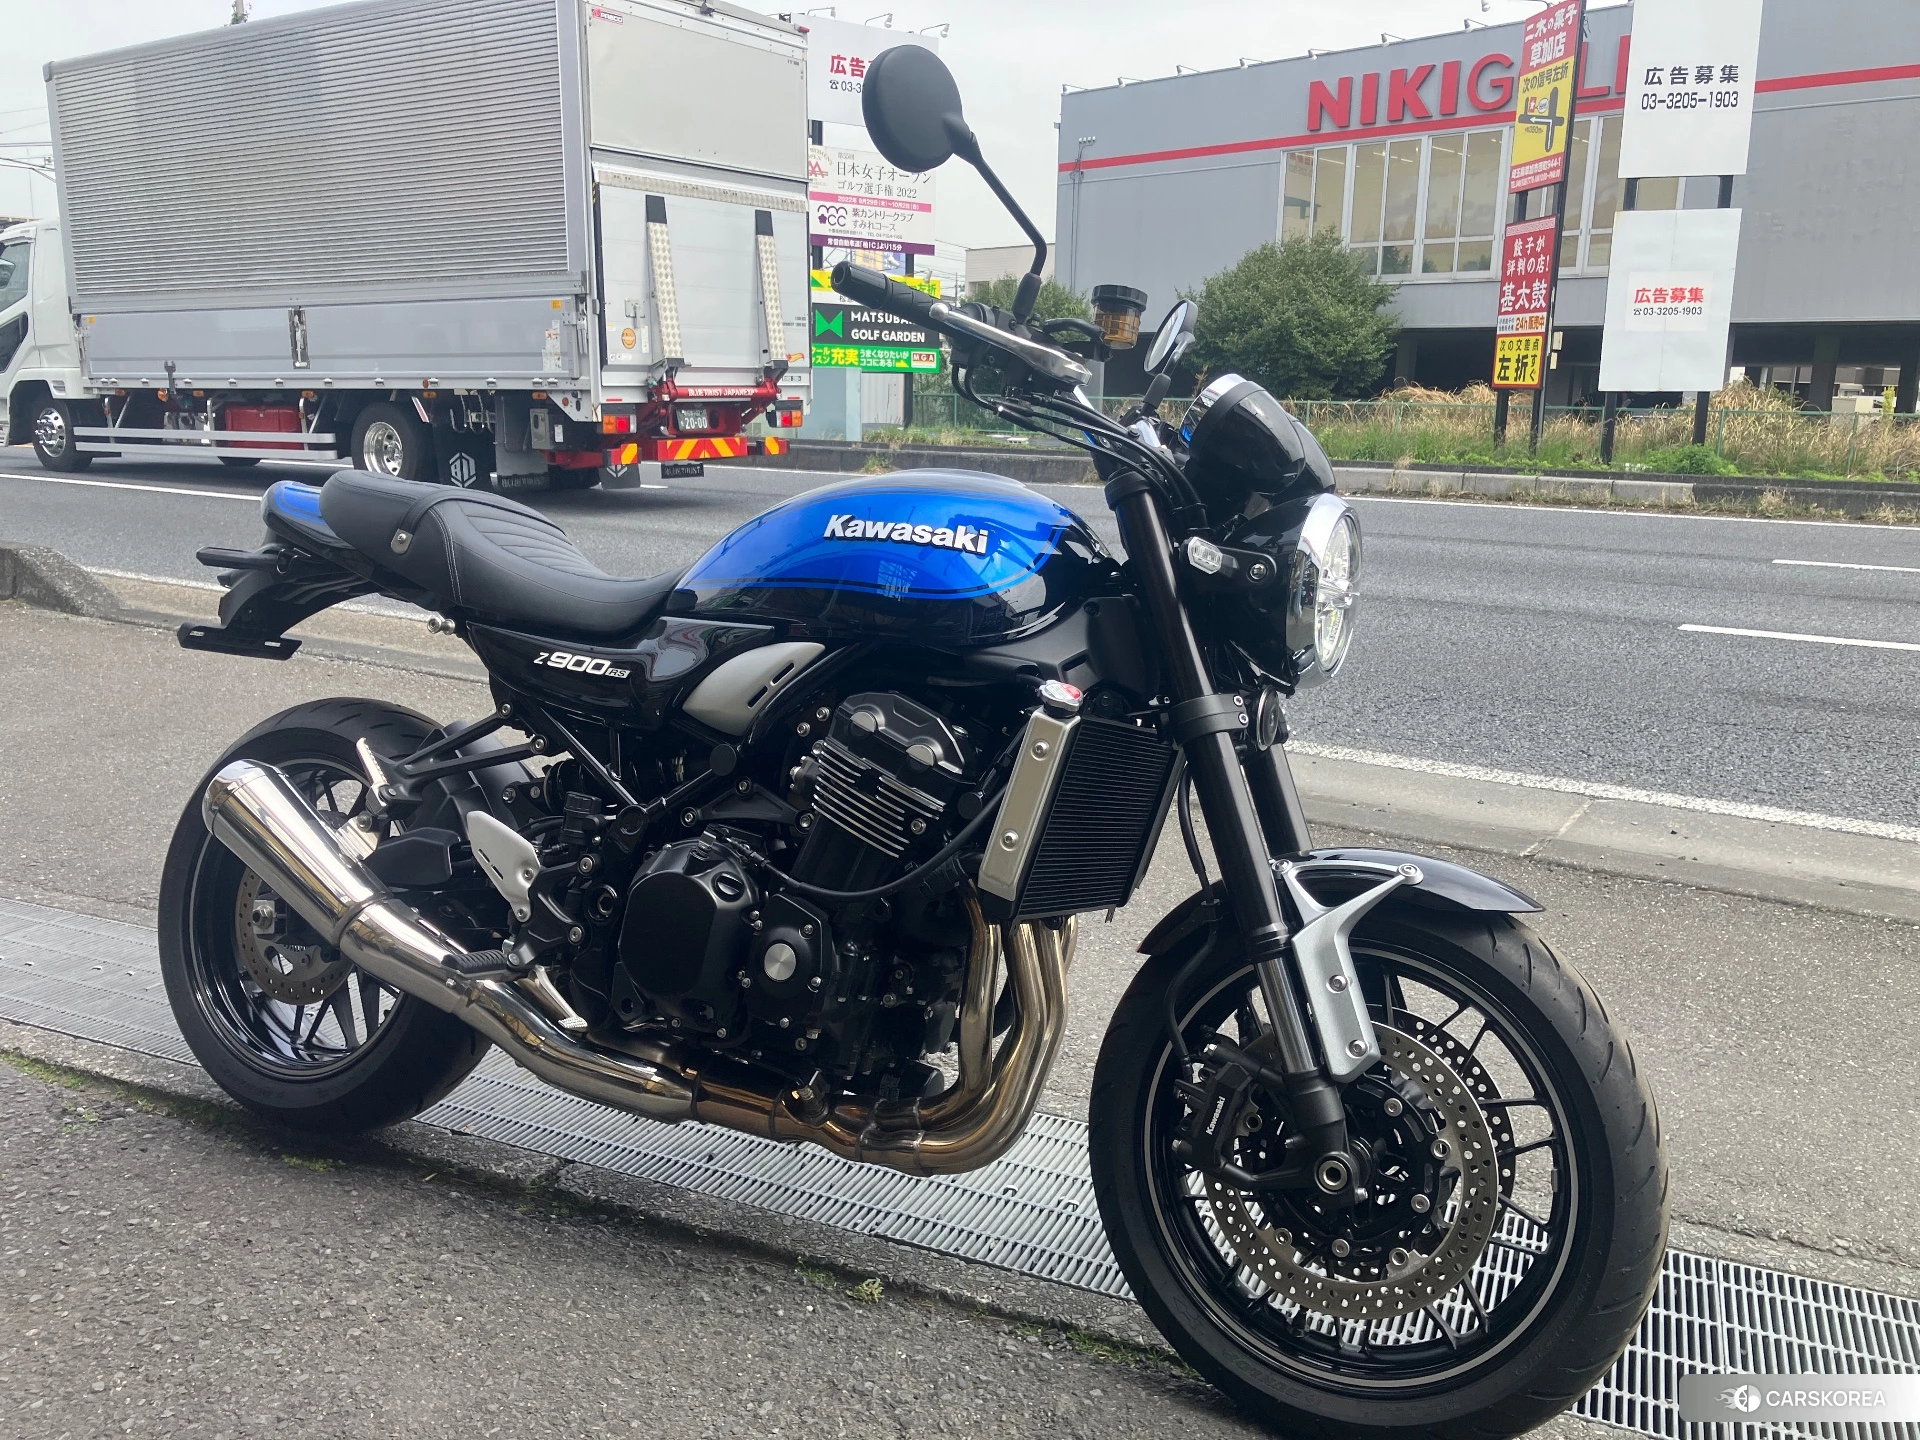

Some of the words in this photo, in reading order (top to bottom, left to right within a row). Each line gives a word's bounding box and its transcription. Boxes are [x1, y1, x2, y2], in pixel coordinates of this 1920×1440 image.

[1525, 3, 1578, 42] 二木の菓子
[1530, 31, 1567, 68] 草加店
[829, 54, 874, 79] 広告
[1643, 64, 1740, 86] 広告募集
[1522, 62, 1569, 94] 次の信号左折
[1641, 91, 1739, 110] 03-3205-1903
[897, 186, 917, 199] 2022
[851, 219, 896, 232] すみれコース
[1513, 235, 1546, 258] 餃子が
[1500, 278, 1548, 313] 甚太鼓
[1633, 287, 1704, 305] 広告募集
[851, 311, 916, 326] MATSUBA
[1643, 307, 1703, 316] 03-3205-1903
[851, 328, 881, 341] GOLF
[882, 330, 925, 343] GARDEN
[1500, 338, 1540, 352] 次の交差点
[831, 348, 859, 365] 充実
[860, 349, 909, 360] うまくなりたいが
[860, 358, 895, 368] ココにある!
[1497, 353, 1529, 382] 左折
[1529, 354, 1538, 382] すぐ
[823, 513, 989, 557] Kawasaki
[1205, 1095, 1226, 1136] Kawasaki
